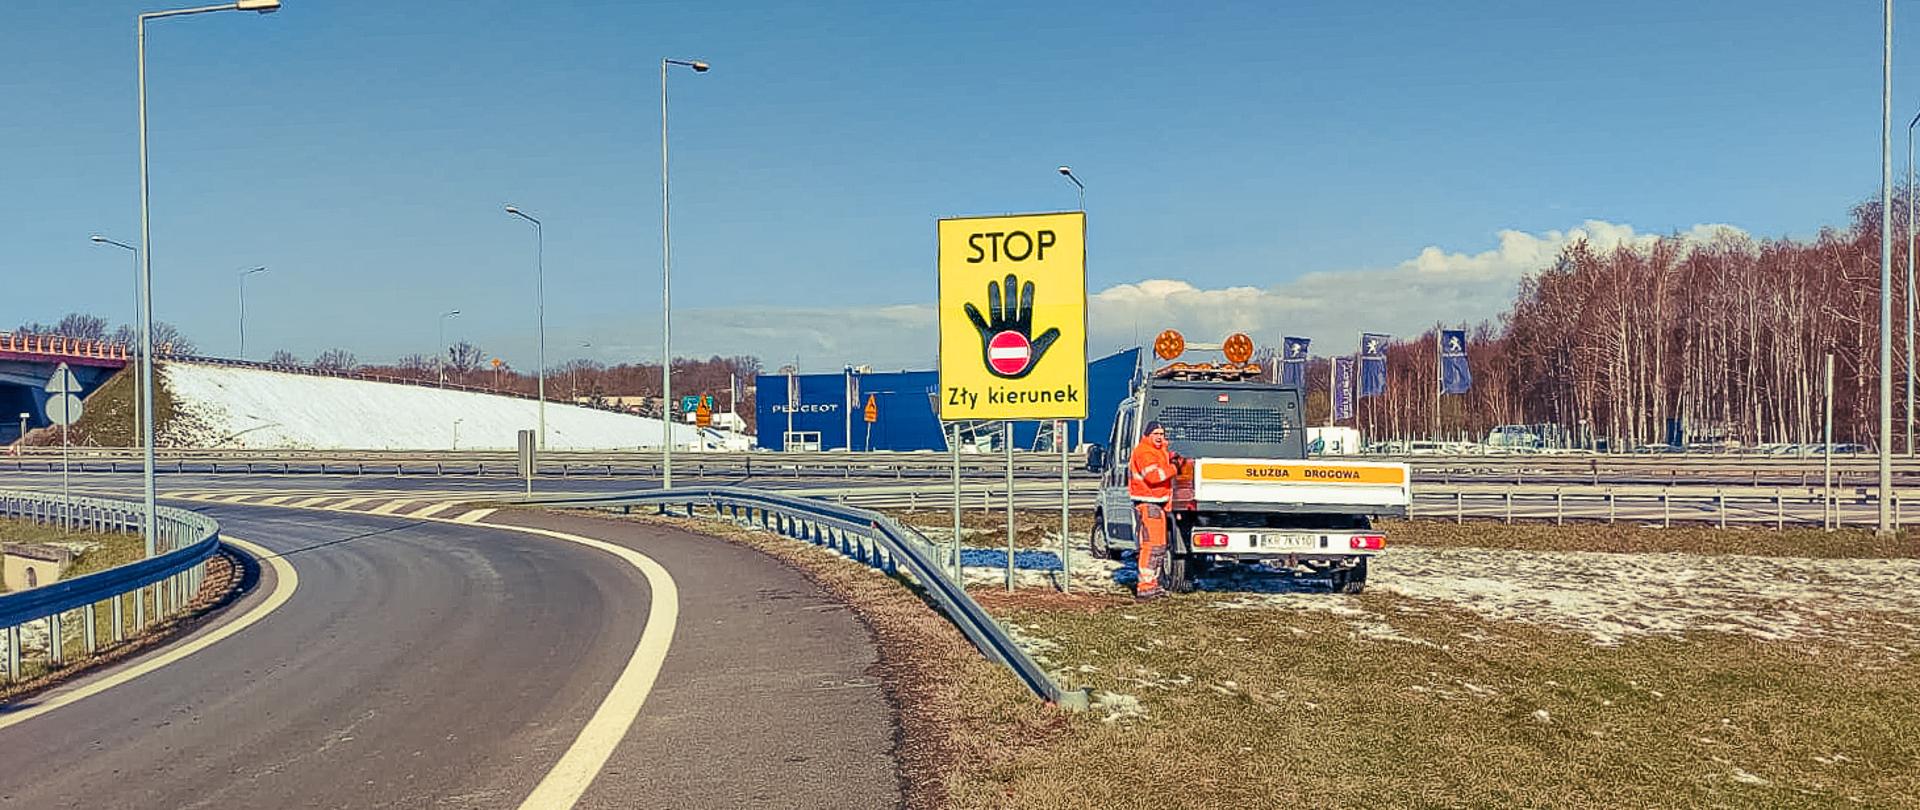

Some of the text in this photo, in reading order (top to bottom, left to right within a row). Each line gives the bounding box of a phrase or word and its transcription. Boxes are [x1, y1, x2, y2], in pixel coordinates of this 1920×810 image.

[966, 230, 1056, 263] STOP
[948, 385, 1078, 410] Zły kierunek
[772, 404, 839, 413] PEUGEOT
[1245, 466, 1361, 479] SŁUŻBA DROGOWA
